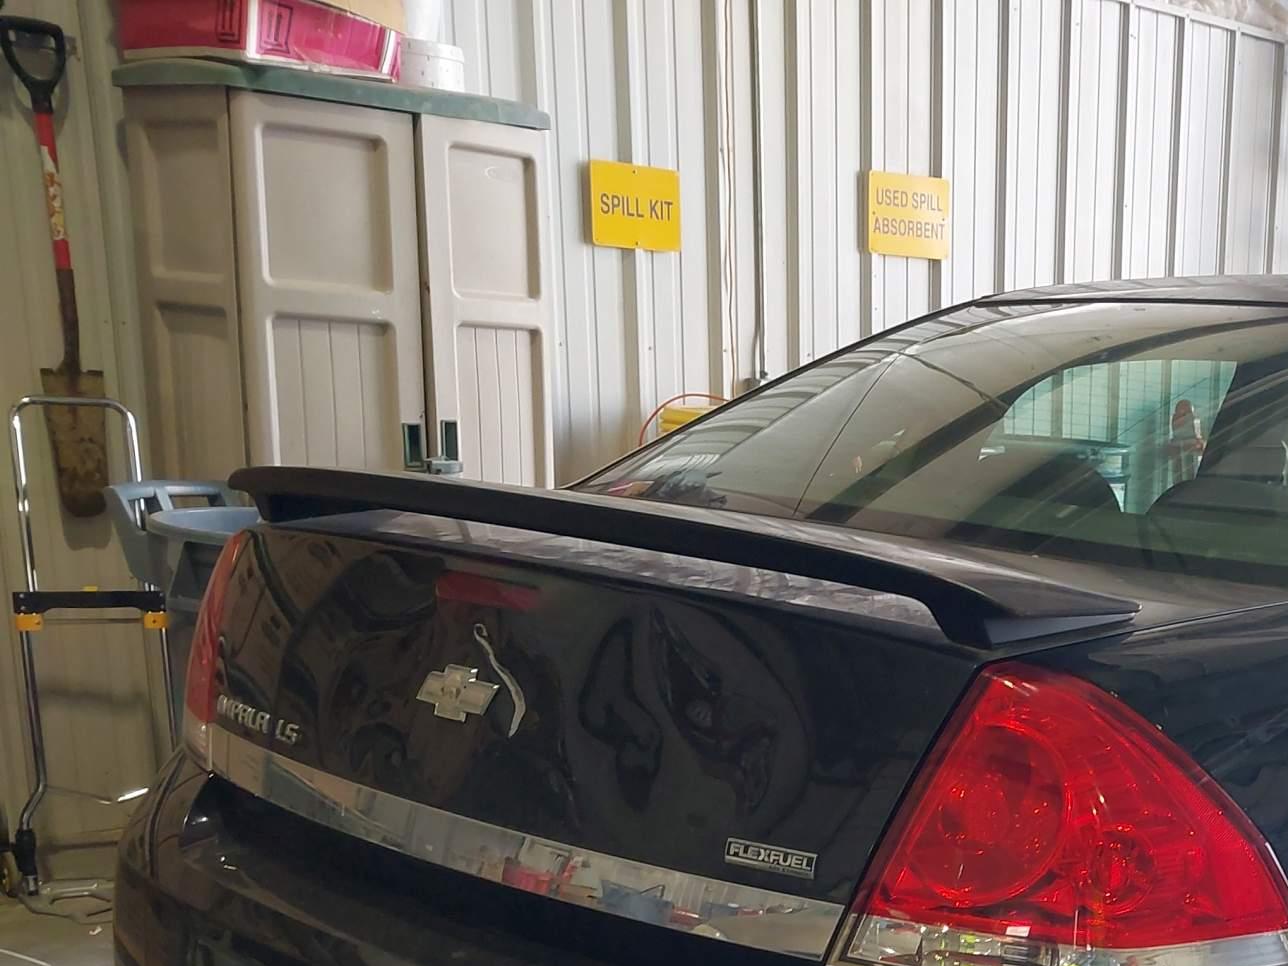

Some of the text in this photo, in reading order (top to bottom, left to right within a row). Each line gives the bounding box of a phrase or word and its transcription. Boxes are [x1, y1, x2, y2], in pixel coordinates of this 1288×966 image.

[600, 192, 673, 222] SPILL KIT
[876, 187, 943, 213] USED SPILL
[872, 219, 946, 241] ABSORBENT
[217, 694, 300, 745] IMPALA LS
[729, 842, 811, 871] FLEXFUEL
